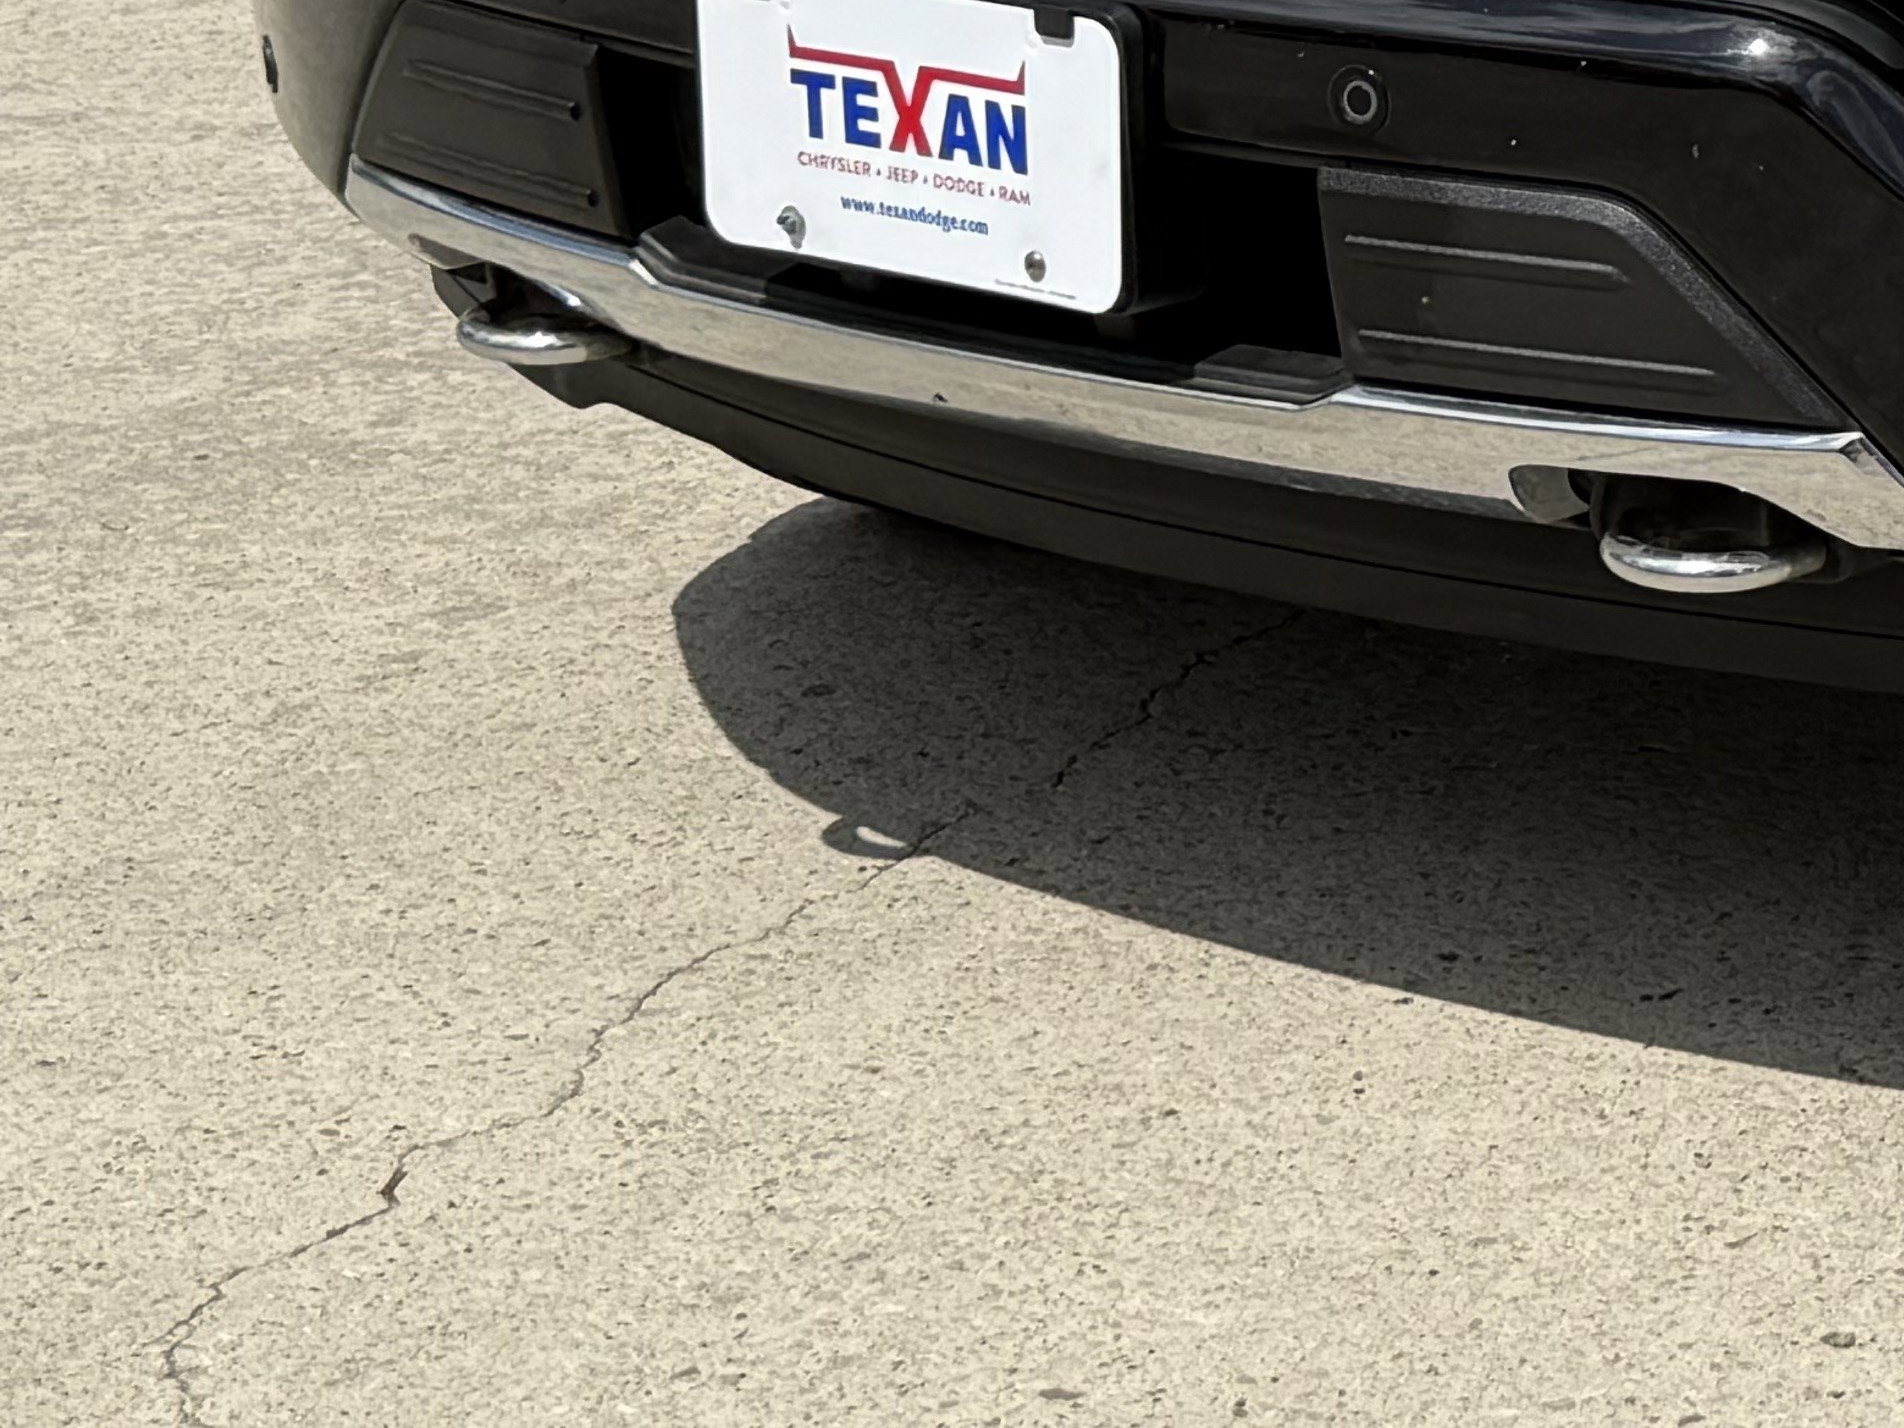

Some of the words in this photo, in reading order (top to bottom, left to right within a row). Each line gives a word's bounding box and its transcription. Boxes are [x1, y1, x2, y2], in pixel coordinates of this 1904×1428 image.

[790, 58, 1029, 175] TEXAN
[797, 150, 872, 178] CHRYSLER
[886, 165, 919, 185] JEEP
[932, 172, 985, 198] DODGE
[998, 185, 1031, 206] RAM
[840, 196, 989, 235] www.texandodge.com
